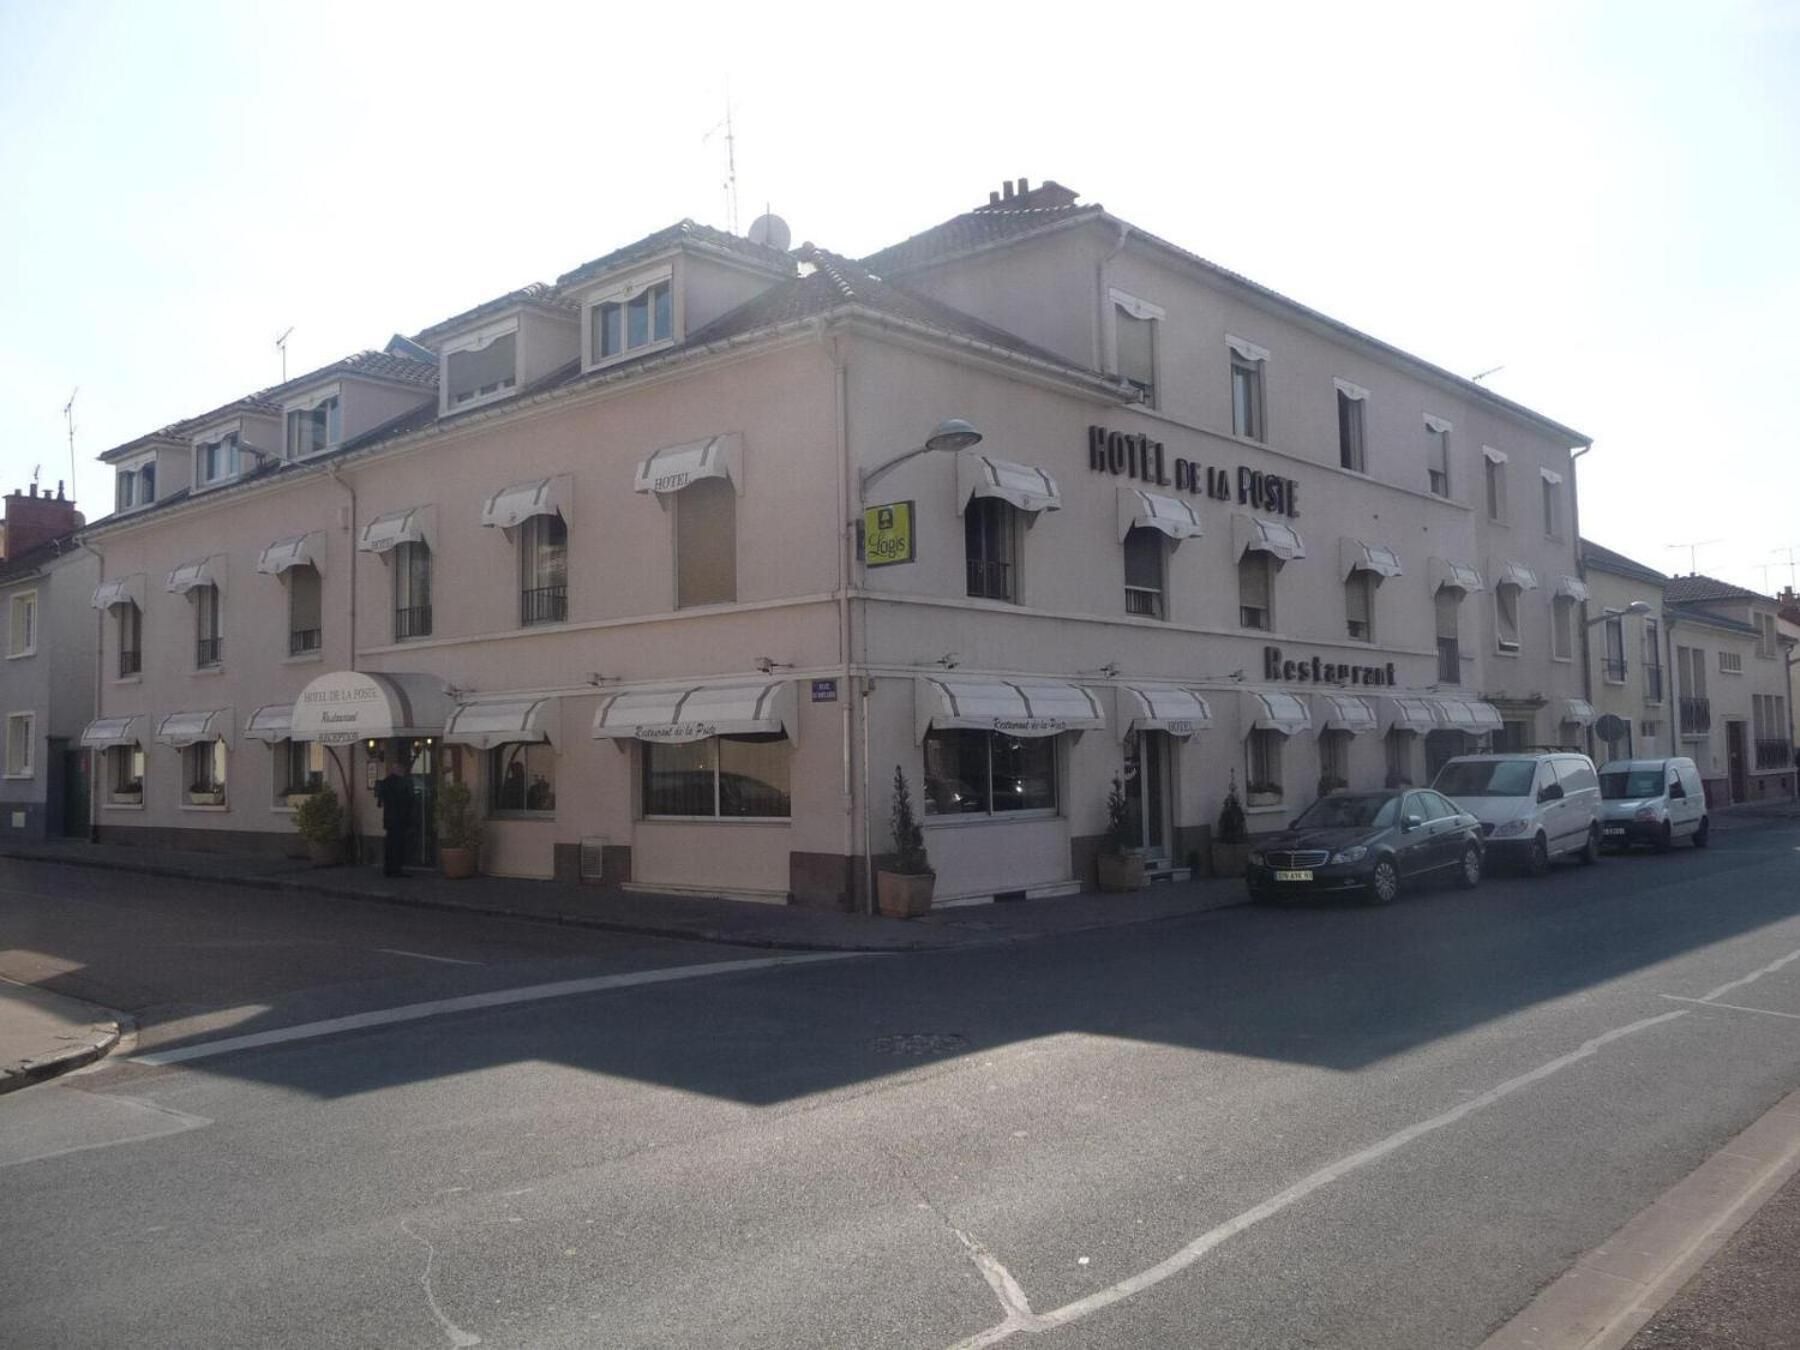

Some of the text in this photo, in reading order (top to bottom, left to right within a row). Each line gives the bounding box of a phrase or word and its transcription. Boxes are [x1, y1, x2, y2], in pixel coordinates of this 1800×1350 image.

[655, 472, 691, 491] HOTEL
[1088, 425, 1300, 519] HOTEL DE LA POSTE
[867, 533, 906, 560] Logis
[1263, 646, 1396, 686] Restaurant
